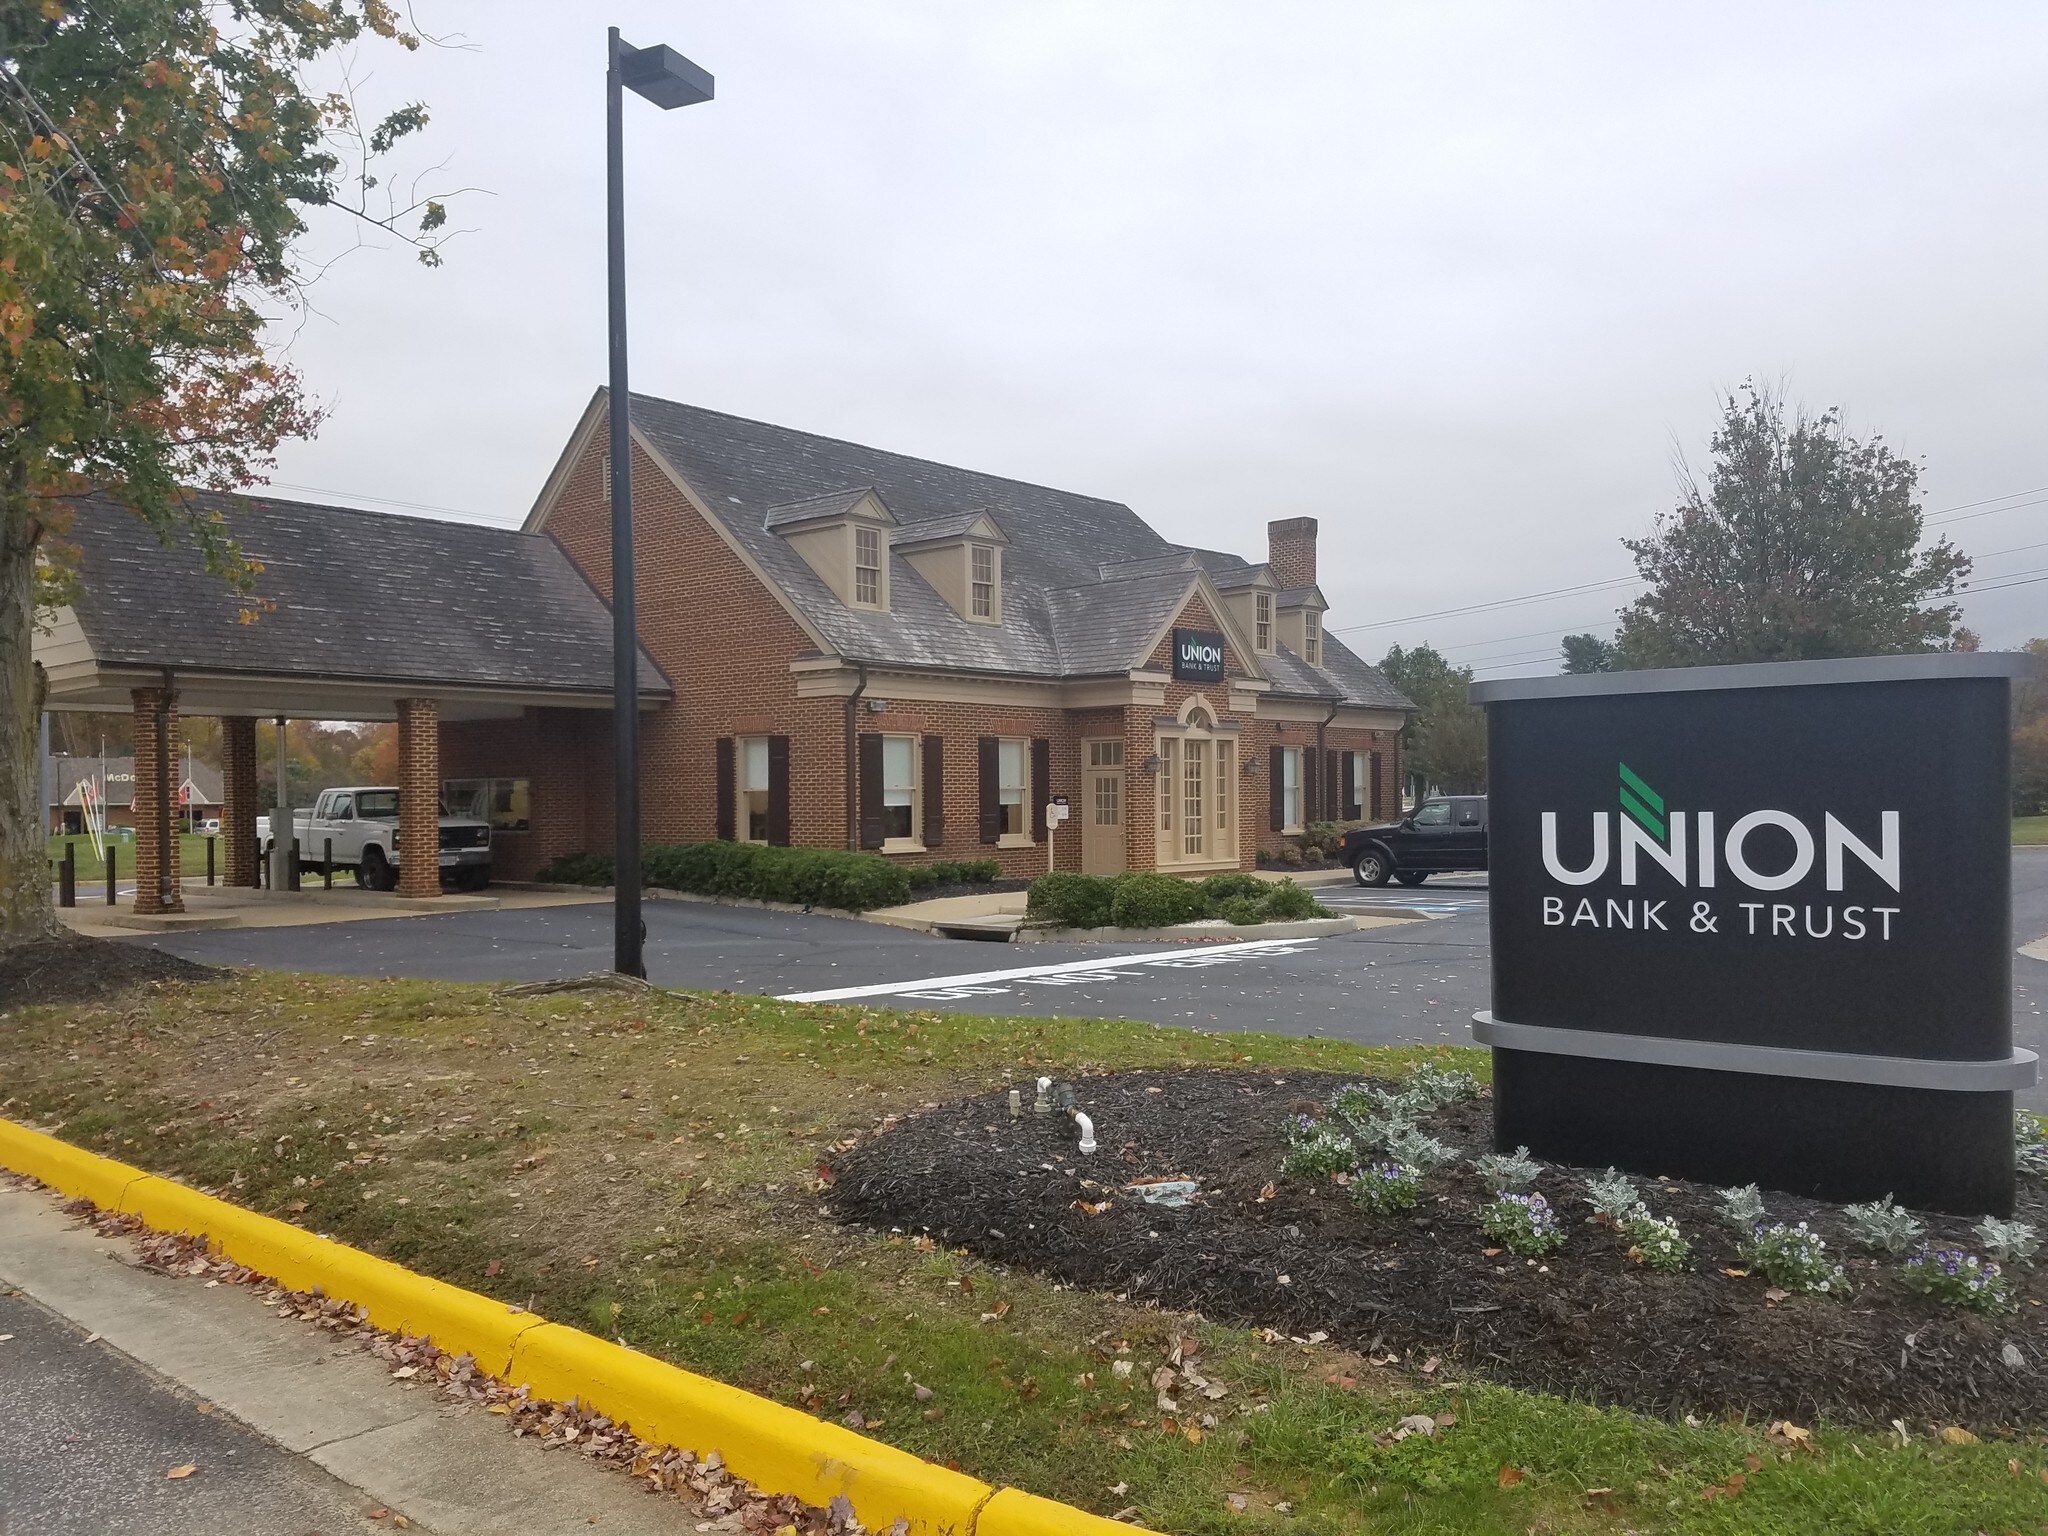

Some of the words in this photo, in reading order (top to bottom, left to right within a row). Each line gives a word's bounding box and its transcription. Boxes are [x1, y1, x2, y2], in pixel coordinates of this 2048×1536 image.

[1181, 644, 1221, 664] UNION
[1181, 662, 1197, 670] BANK
[1203, 664, 1220, 672] TRUST
[1541, 809, 1901, 893] UNION
[1543, 896, 1668, 931] BANK
[1689, 901, 1718, 933] &
[1739, 902, 1900, 940] TRUST
[893, 986, 1012, 1000] DO
[1013, 968, 1147, 986] NOT
[1142, 947, 1320, 968] ENTER
